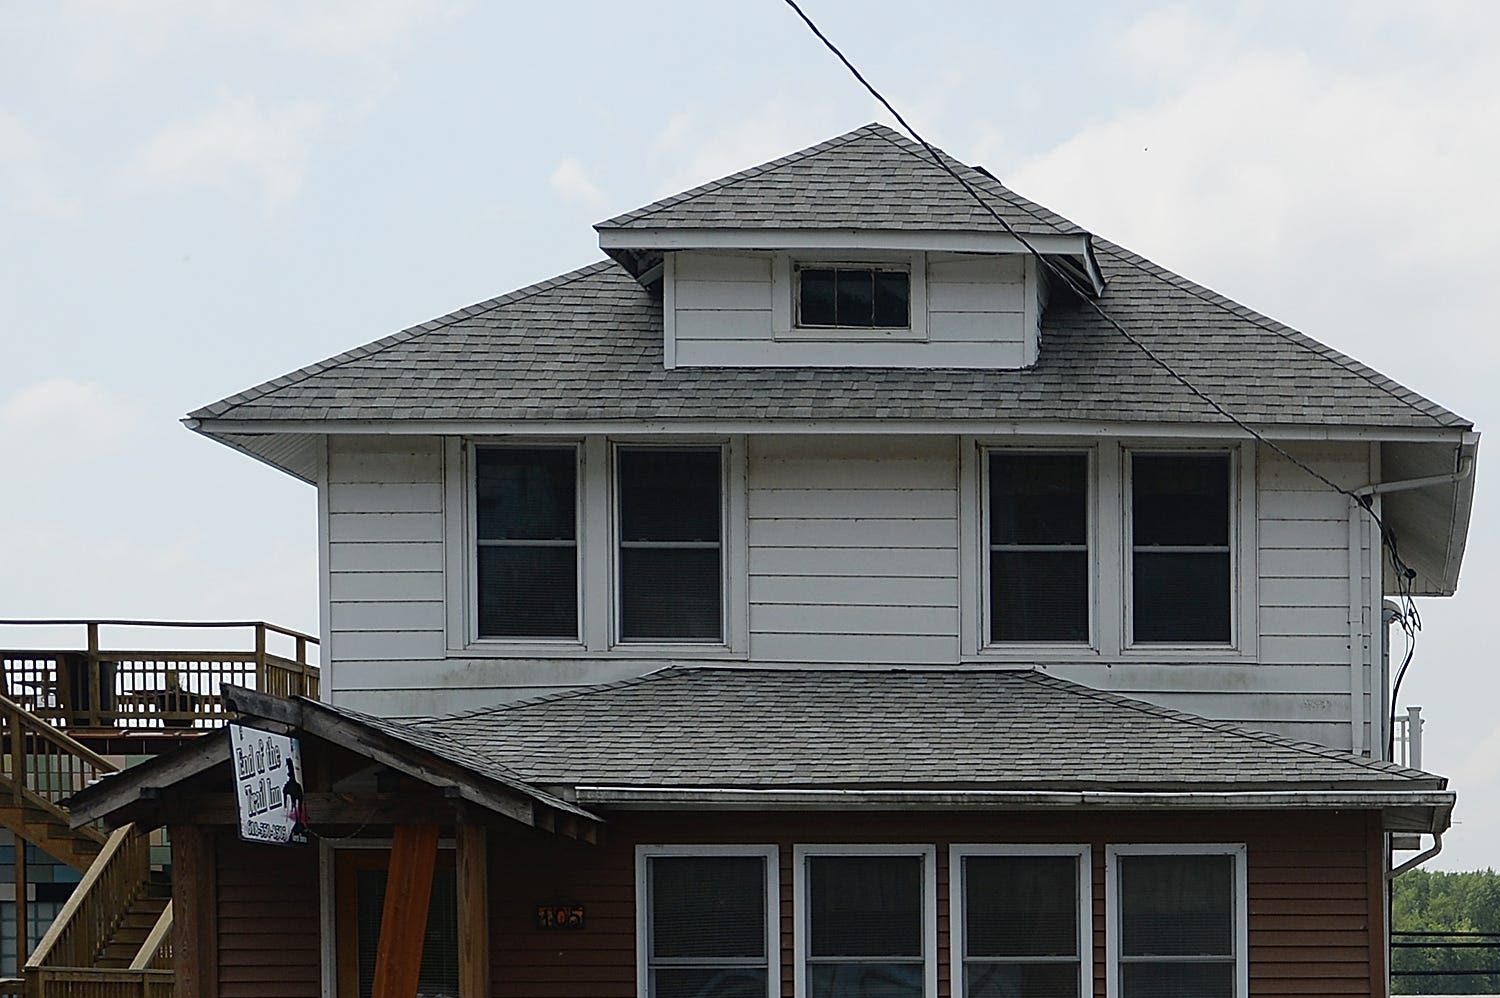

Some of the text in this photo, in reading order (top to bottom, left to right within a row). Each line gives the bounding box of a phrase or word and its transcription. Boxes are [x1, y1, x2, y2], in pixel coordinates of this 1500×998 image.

[236, 736, 281, 781] End of the
[245, 777, 283, 818] Trail Inn
